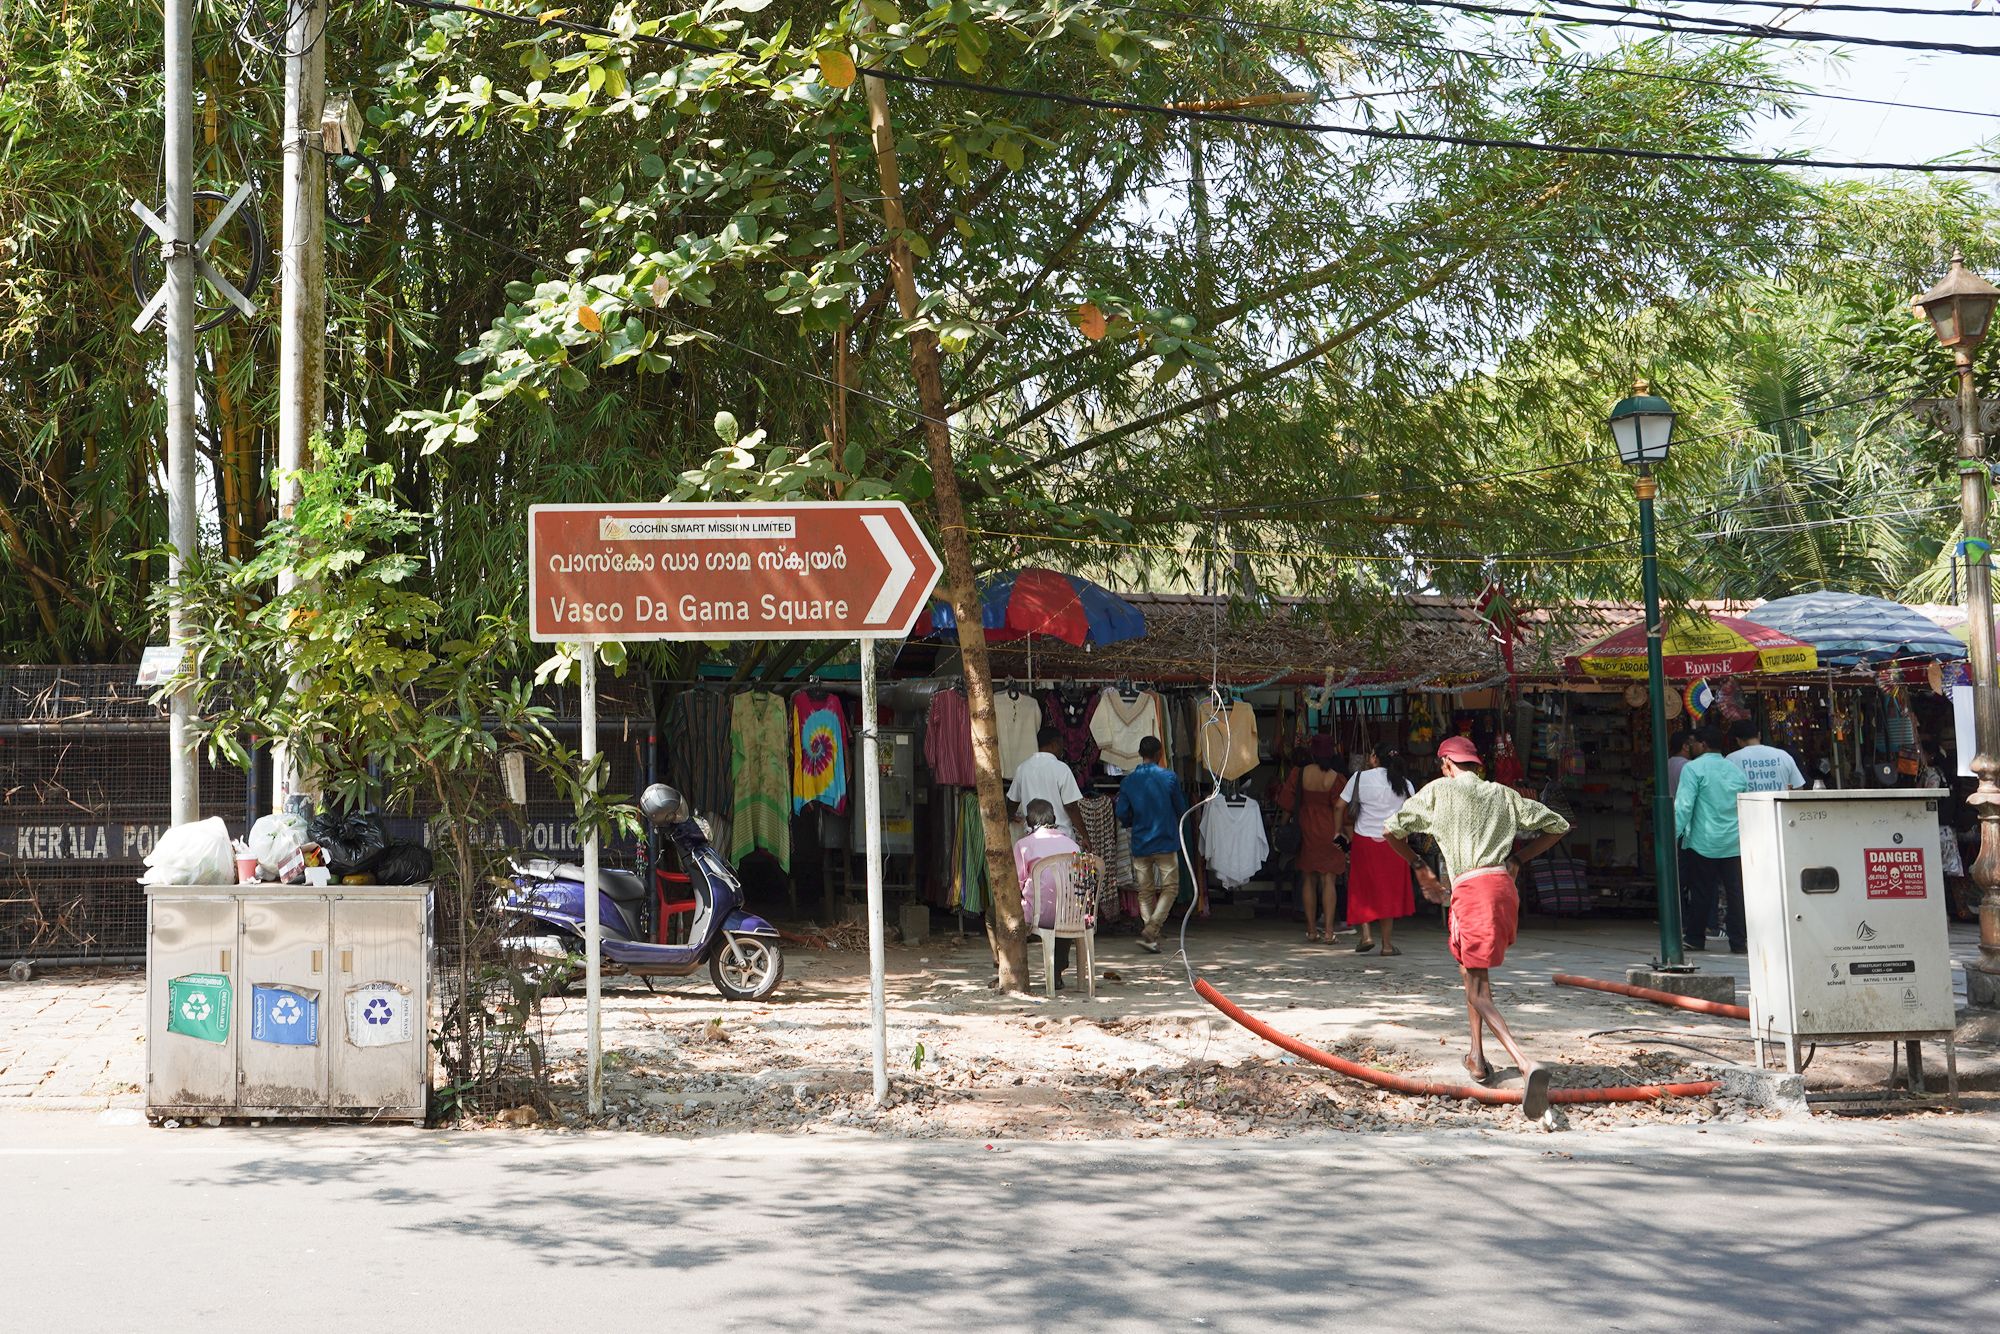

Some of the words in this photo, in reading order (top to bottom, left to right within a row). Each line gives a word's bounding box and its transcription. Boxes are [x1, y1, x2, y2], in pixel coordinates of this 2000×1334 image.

[629, 524, 668, 534] COCHIN
[671, 523, 706, 533] SMART
[708, 523, 750, 533] MISSION
[753, 522, 792, 532] LIMITED
[549, 547, 656, 573] വാസ്കോ
[661, 553, 700, 572] ഡാ
[705, 552, 752, 571] ഗാമ
[550, 596, 624, 623] Vasco
[636, 595, 669, 622] Da
[679, 594, 750, 622] Gama
[760, 593, 849, 625] Square
[1685, 659, 1732, 674] EDWISE
[1742, 757, 1781, 769] Please!
[1748, 771, 1776, 780] Drive
[1748, 781, 1782, 791] Slowly
[17, 826, 108, 859] KERALA
[1869, 851, 1919, 863] DANGER
[1899, 864, 1923, 872] VOLTS
